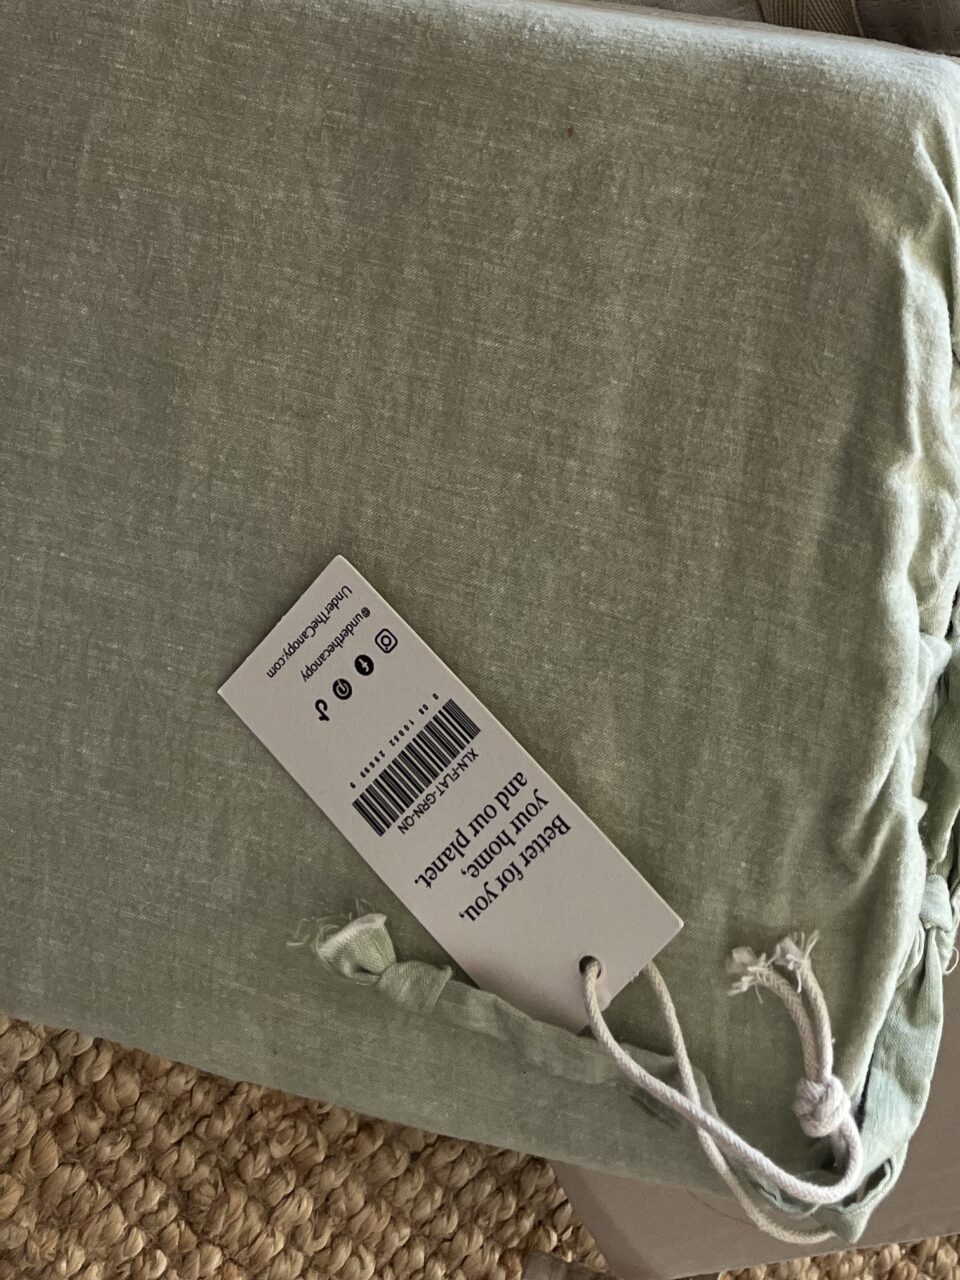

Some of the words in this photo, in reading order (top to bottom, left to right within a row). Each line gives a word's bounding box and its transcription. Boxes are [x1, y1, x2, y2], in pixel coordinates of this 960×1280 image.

[266, 585, 353, 679] UnderTheCanopy.com
[300, 606, 371, 683] @underthecanopy
[397, 747, 479, 835] XLN-FLAT-GRN-QN
[494, 771, 528, 812] and
[509, 788, 549, 835] your
[467, 803, 498, 838] our
[518, 814, 571, 868] Better
[414, 827, 471, 889] planet.
[460, 831, 516, 879] home,
[495, 861, 524, 892] for
[458, 881, 499, 922] you,
